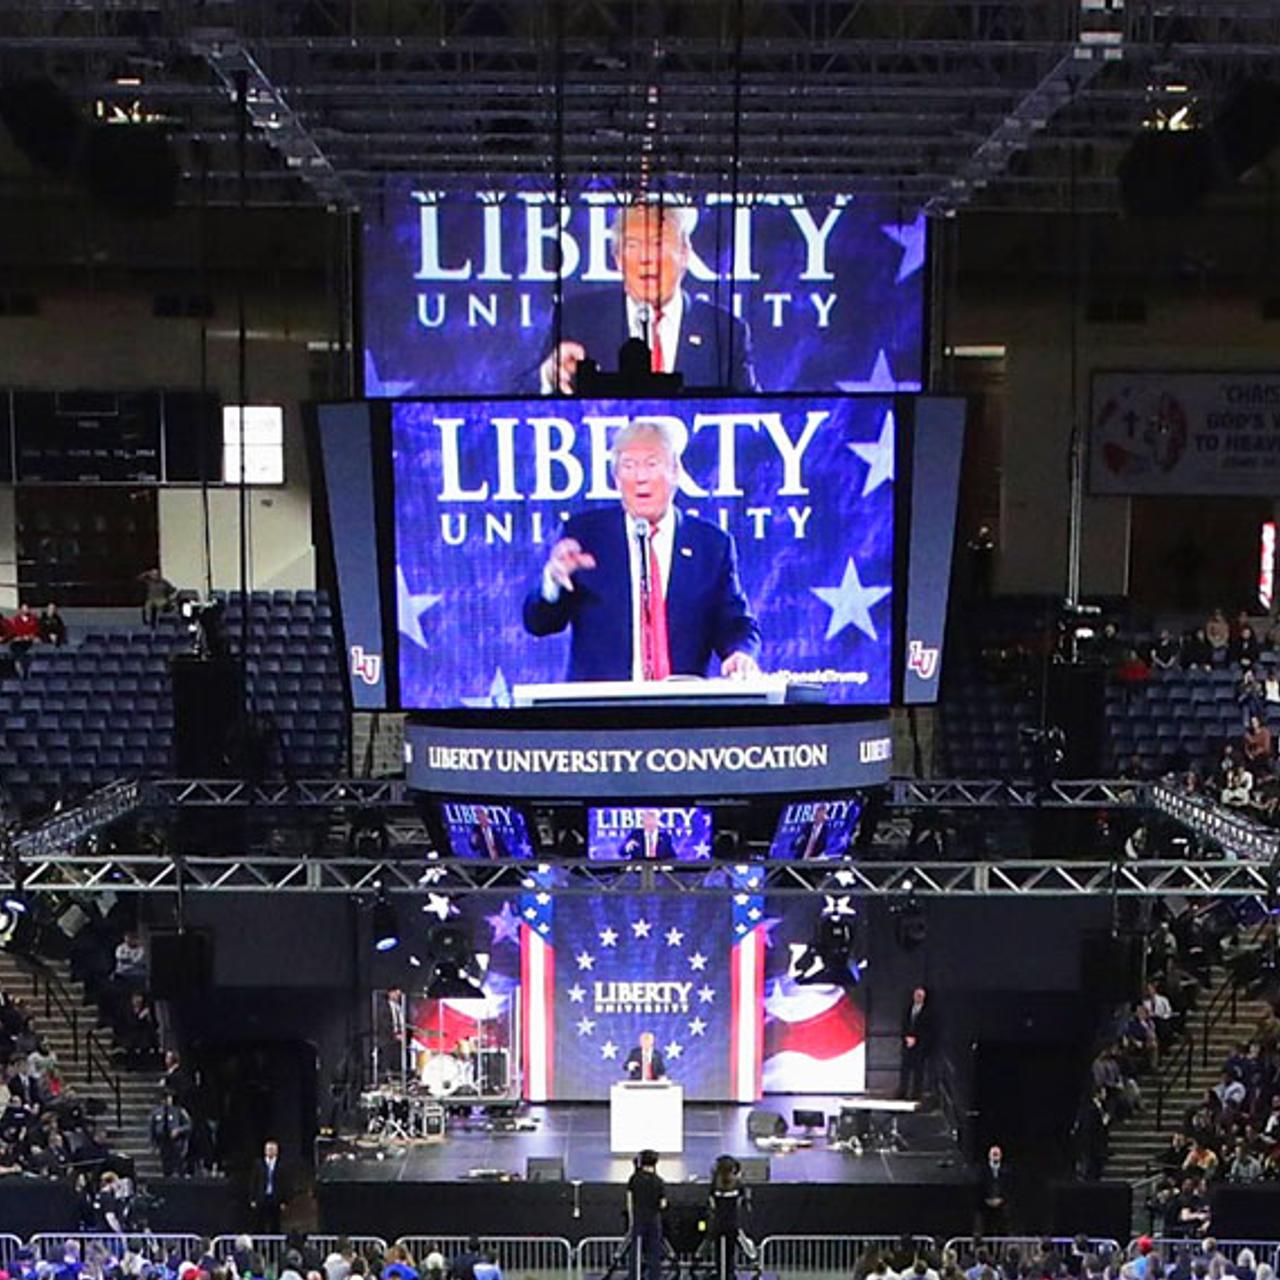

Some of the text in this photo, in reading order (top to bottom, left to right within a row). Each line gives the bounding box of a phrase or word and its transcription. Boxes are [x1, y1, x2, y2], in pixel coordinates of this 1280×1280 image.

[428, 746, 493, 770] LIBERTY
[497, 750, 643, 772] UNIVERSITY
[646, 744, 827, 772] CONVOCATION
[594, 982, 693, 1003] LIBERTY
